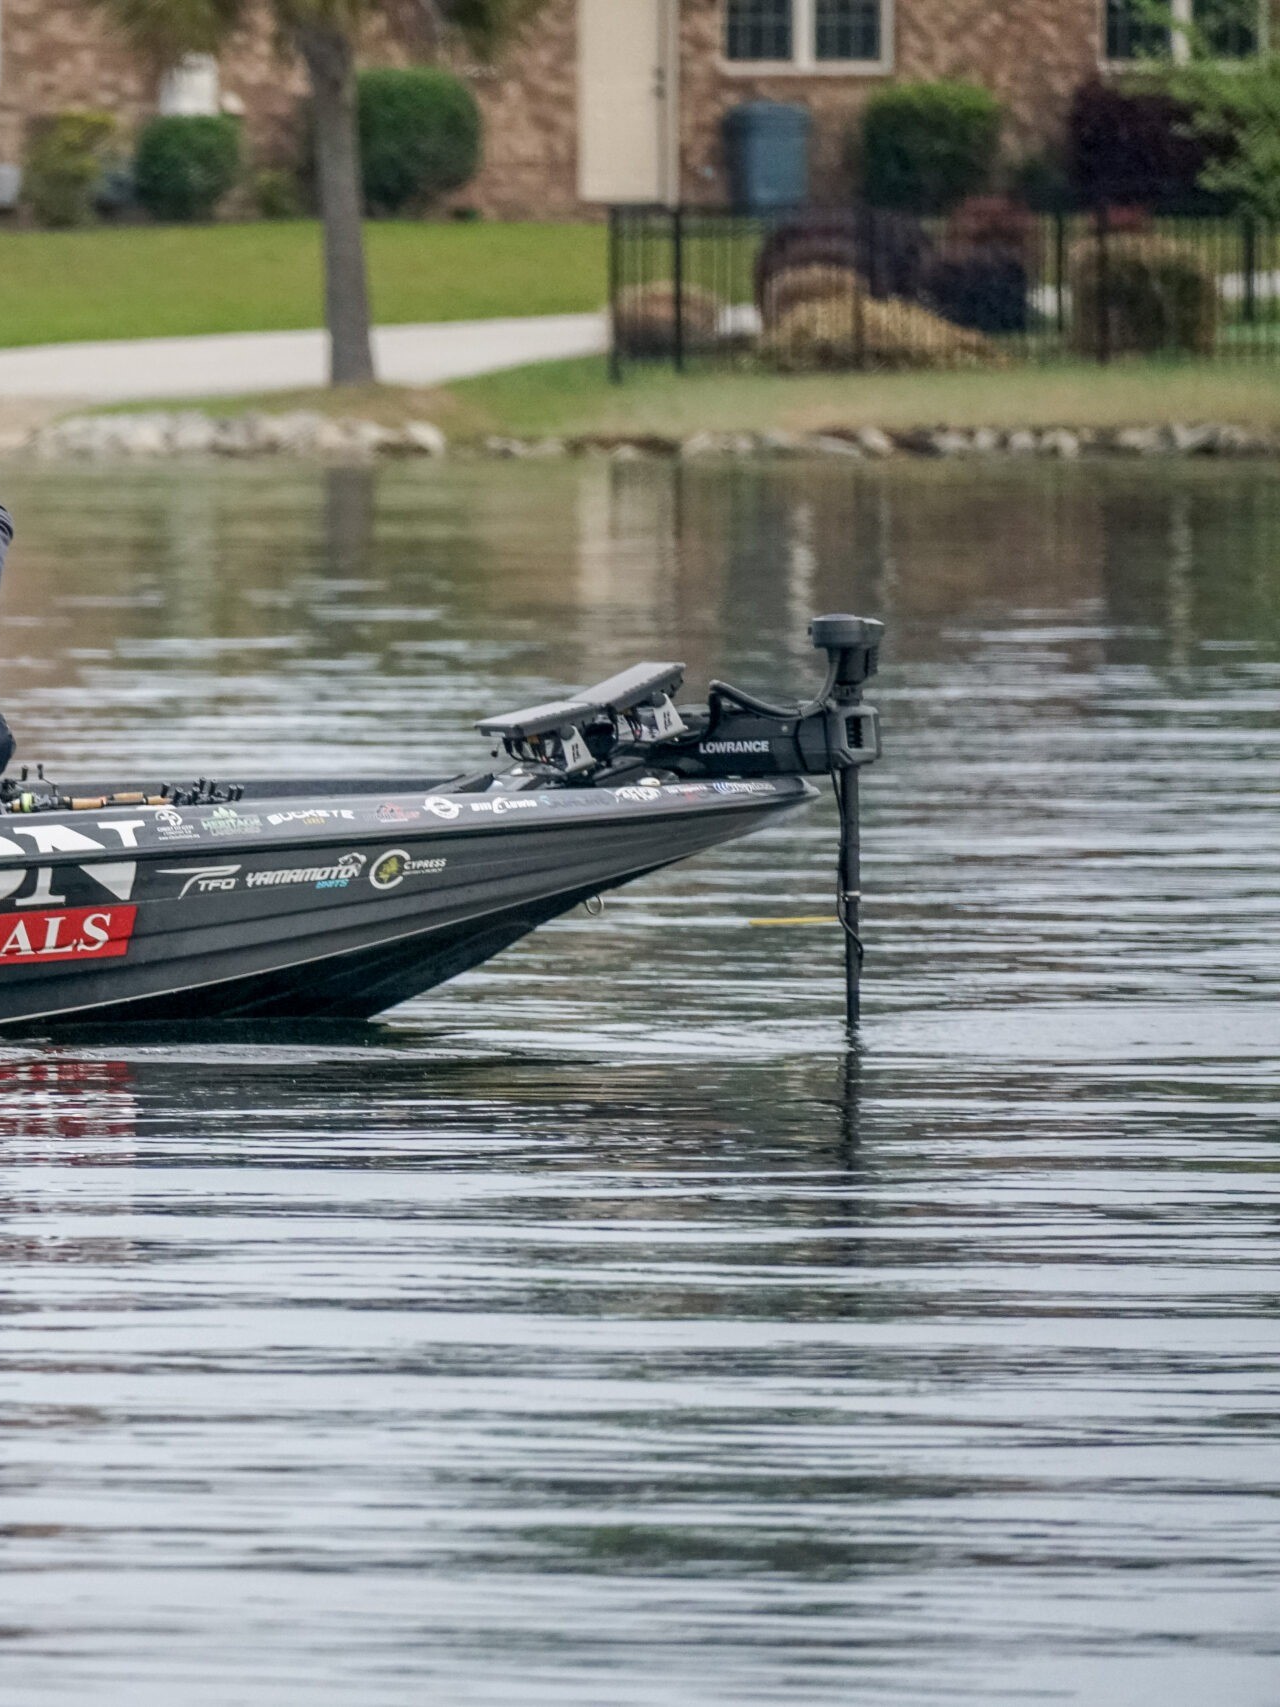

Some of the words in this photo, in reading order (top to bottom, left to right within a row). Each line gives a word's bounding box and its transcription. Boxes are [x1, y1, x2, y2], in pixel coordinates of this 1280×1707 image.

[699, 740, 770, 754] LOWRANCE
[403, 857, 448, 871] CYPRESS
[245, 864, 353, 889] YAMAMOTO
[197, 879, 237, 892] TFO
